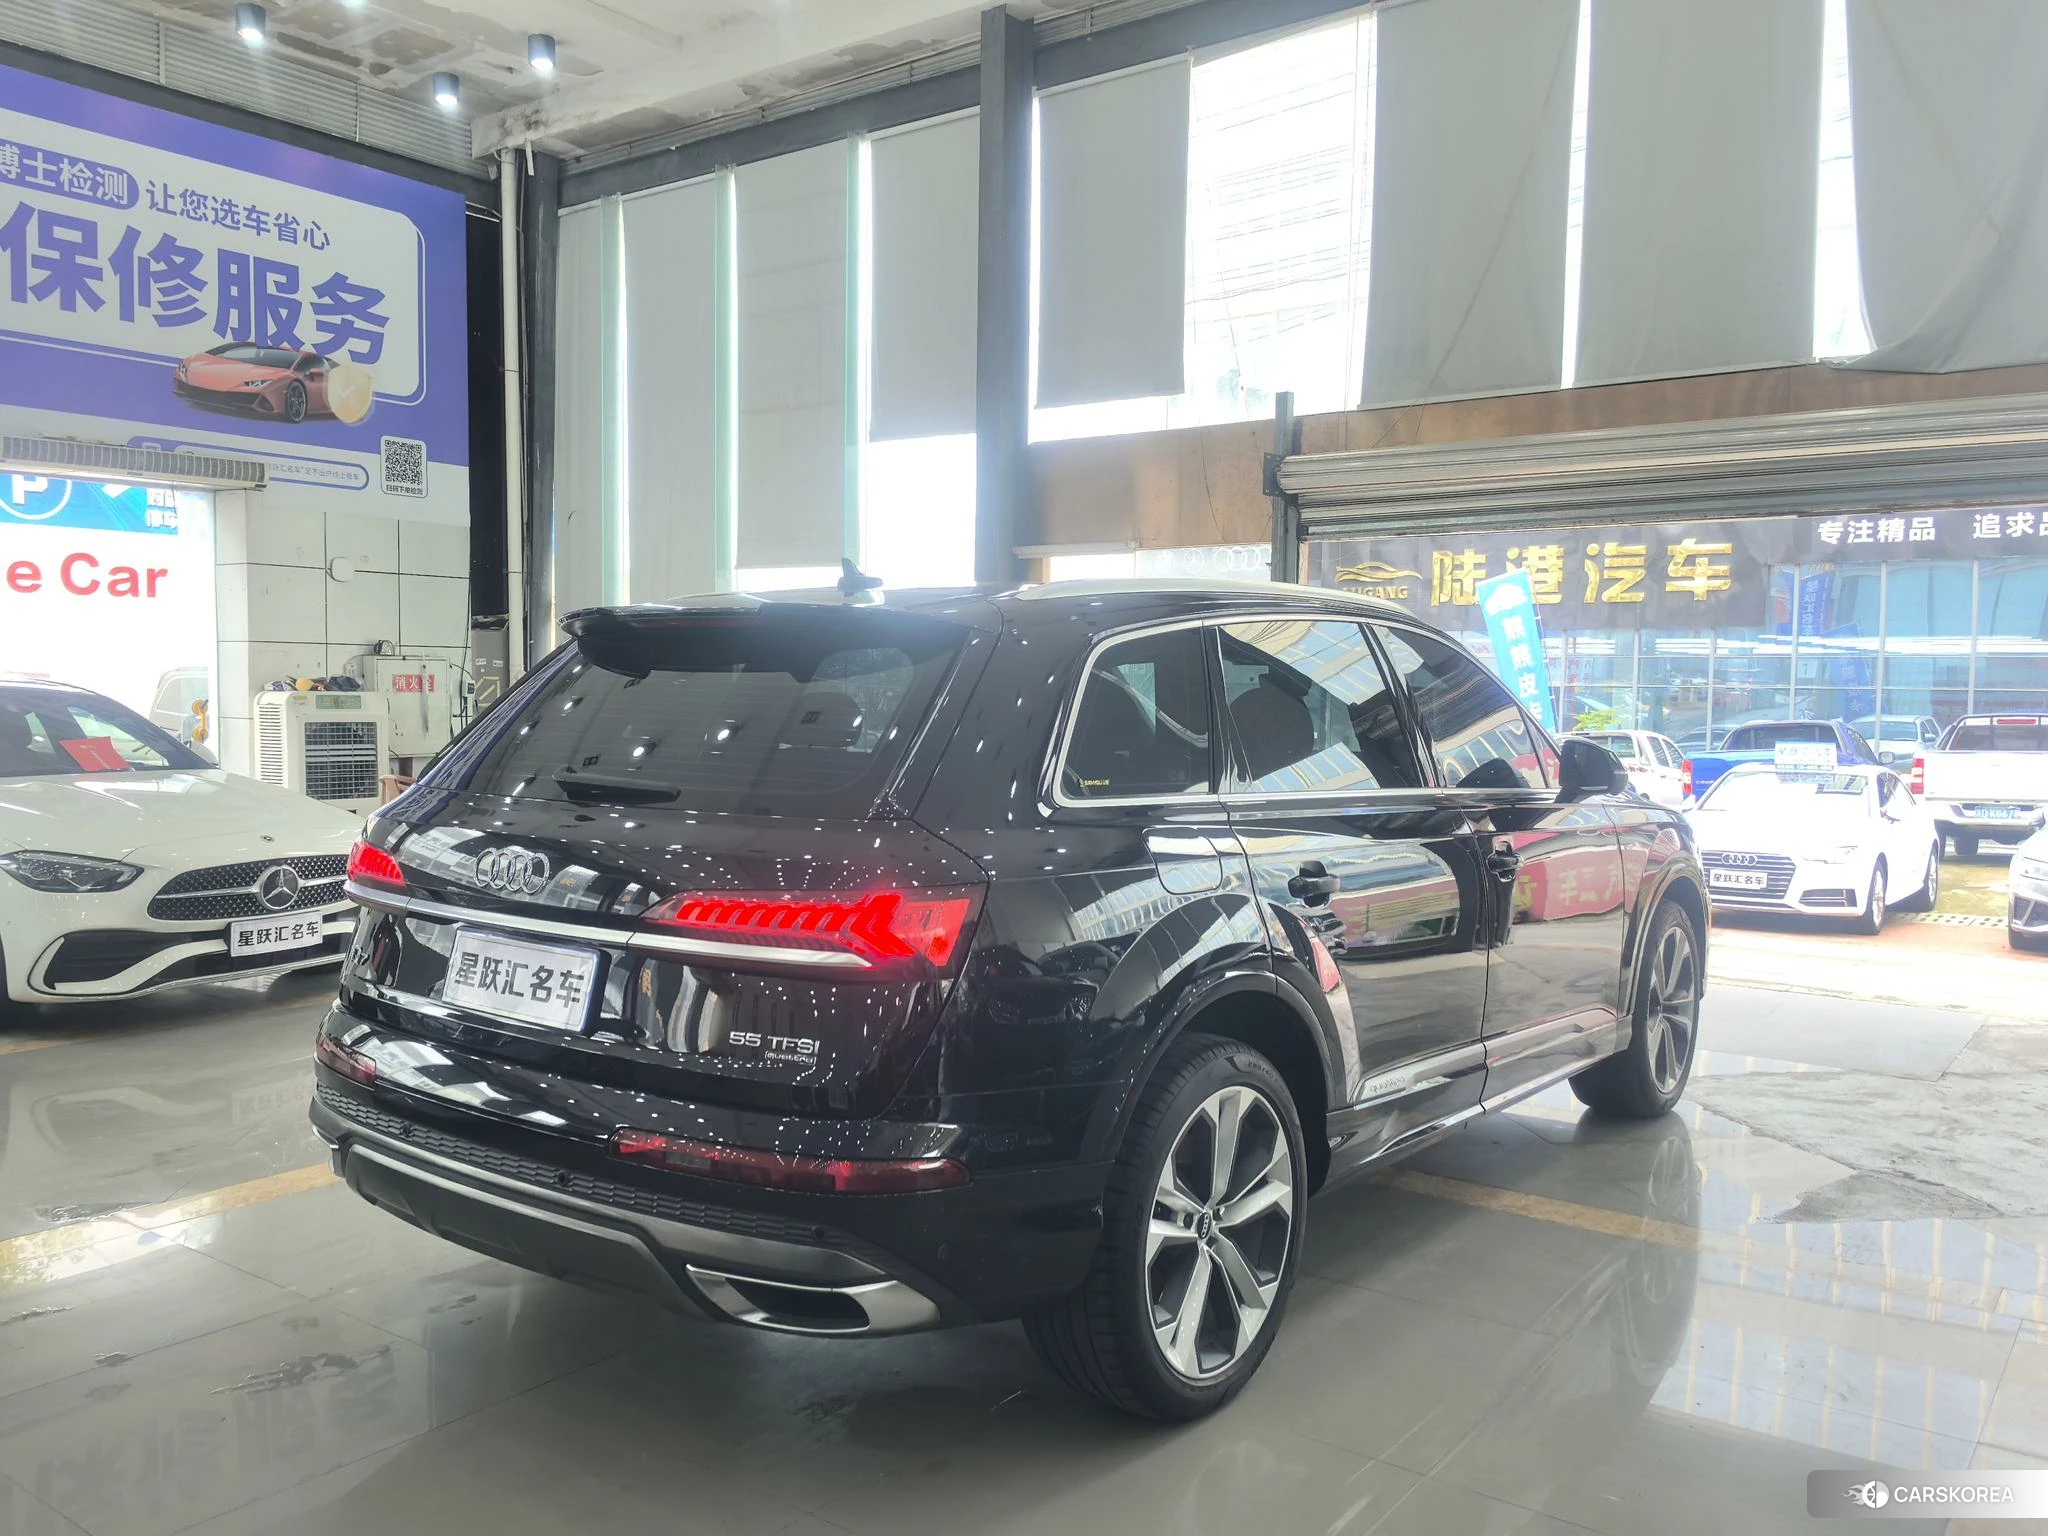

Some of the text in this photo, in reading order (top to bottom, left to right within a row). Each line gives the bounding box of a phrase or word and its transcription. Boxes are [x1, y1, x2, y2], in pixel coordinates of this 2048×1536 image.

[0, 144, 330, 250] 博士检测 让您选车省心
[0, 201, 390, 365] 保修服务
[1817, 516, 1936, 545] 专注精品
[60, 552, 168, 598] Car
[1431, 538, 1732, 607] 陆港汽车
[1713, 873, 1765, 885] 星跃汇名车
[237, 921, 319, 947] 星跃汇名车
[454, 951, 585, 1008] 星跃汇名车
[729, 1031, 820, 1055] 55 TFSI
